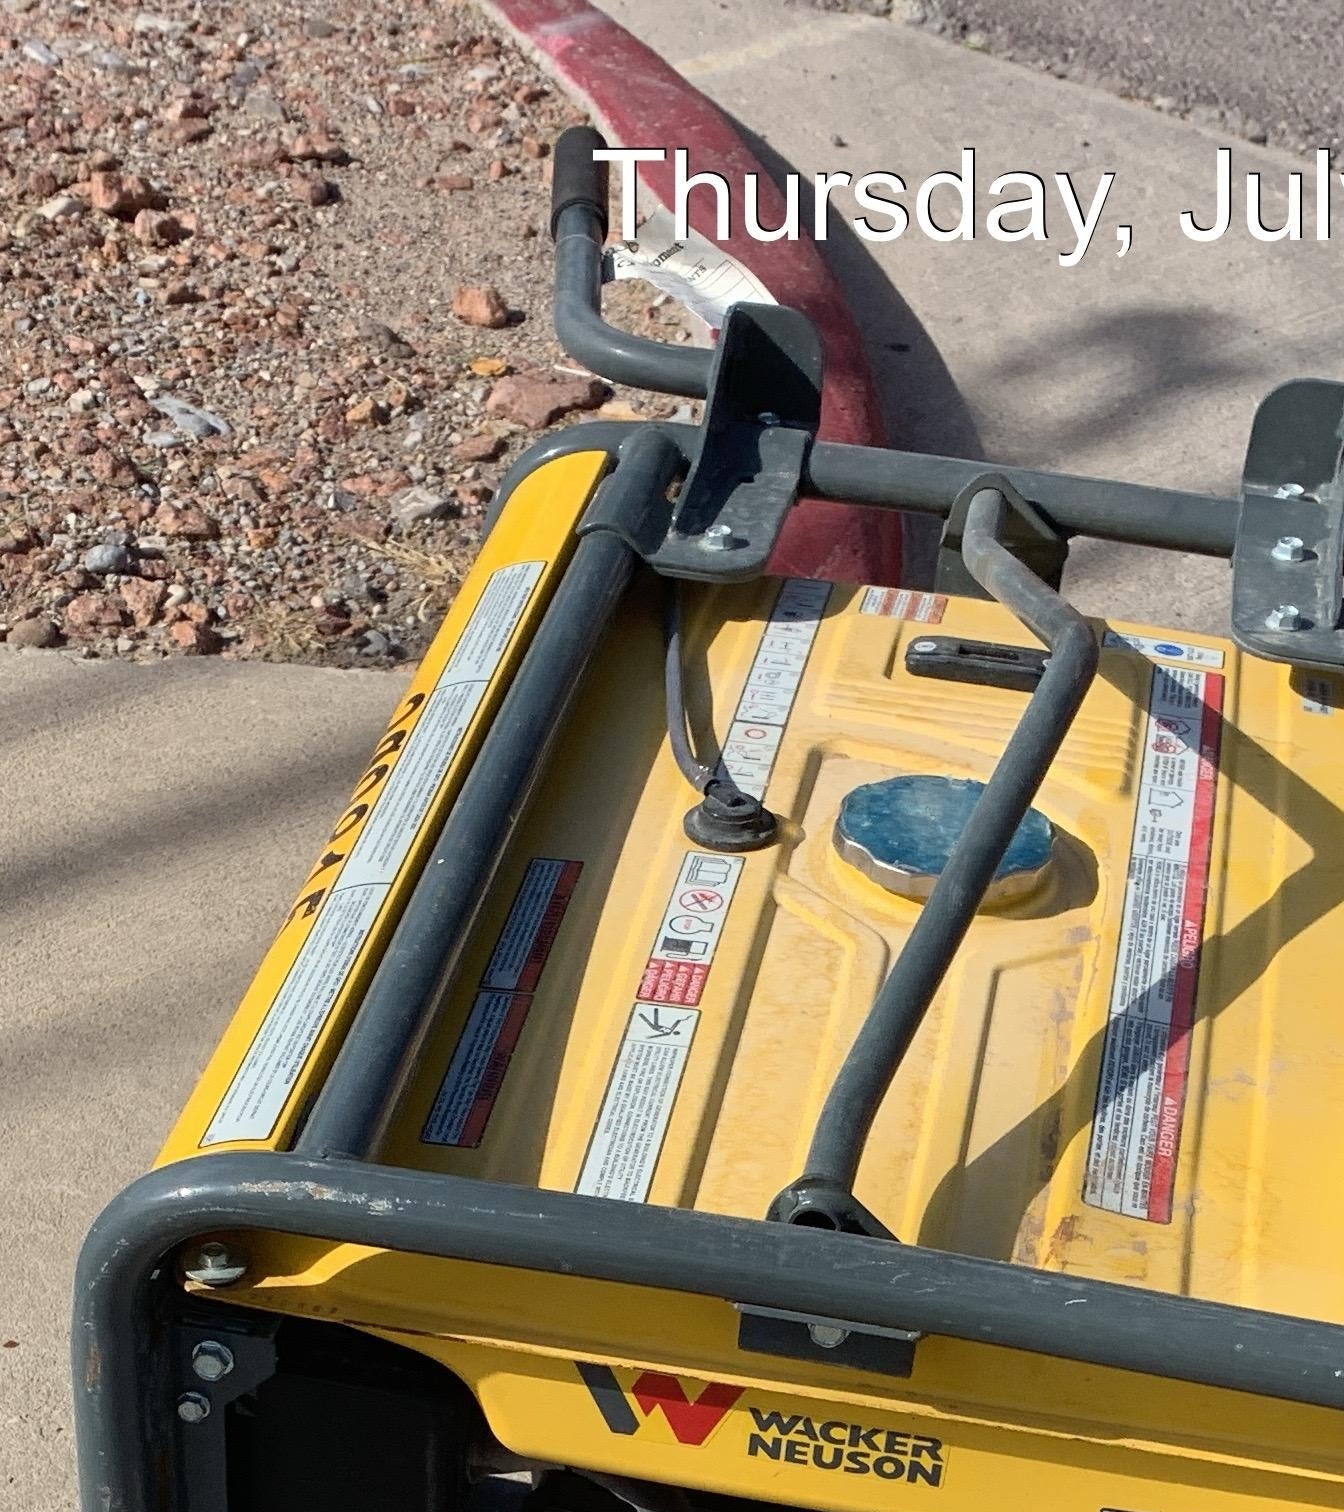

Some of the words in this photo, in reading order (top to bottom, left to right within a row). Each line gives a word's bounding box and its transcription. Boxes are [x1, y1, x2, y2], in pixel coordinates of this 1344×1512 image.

[1157, 1105, 1177, 1158] DANGER
[747, 1432, 945, 1489] NEUSON
[748, 1406, 945, 1463] WACKER
